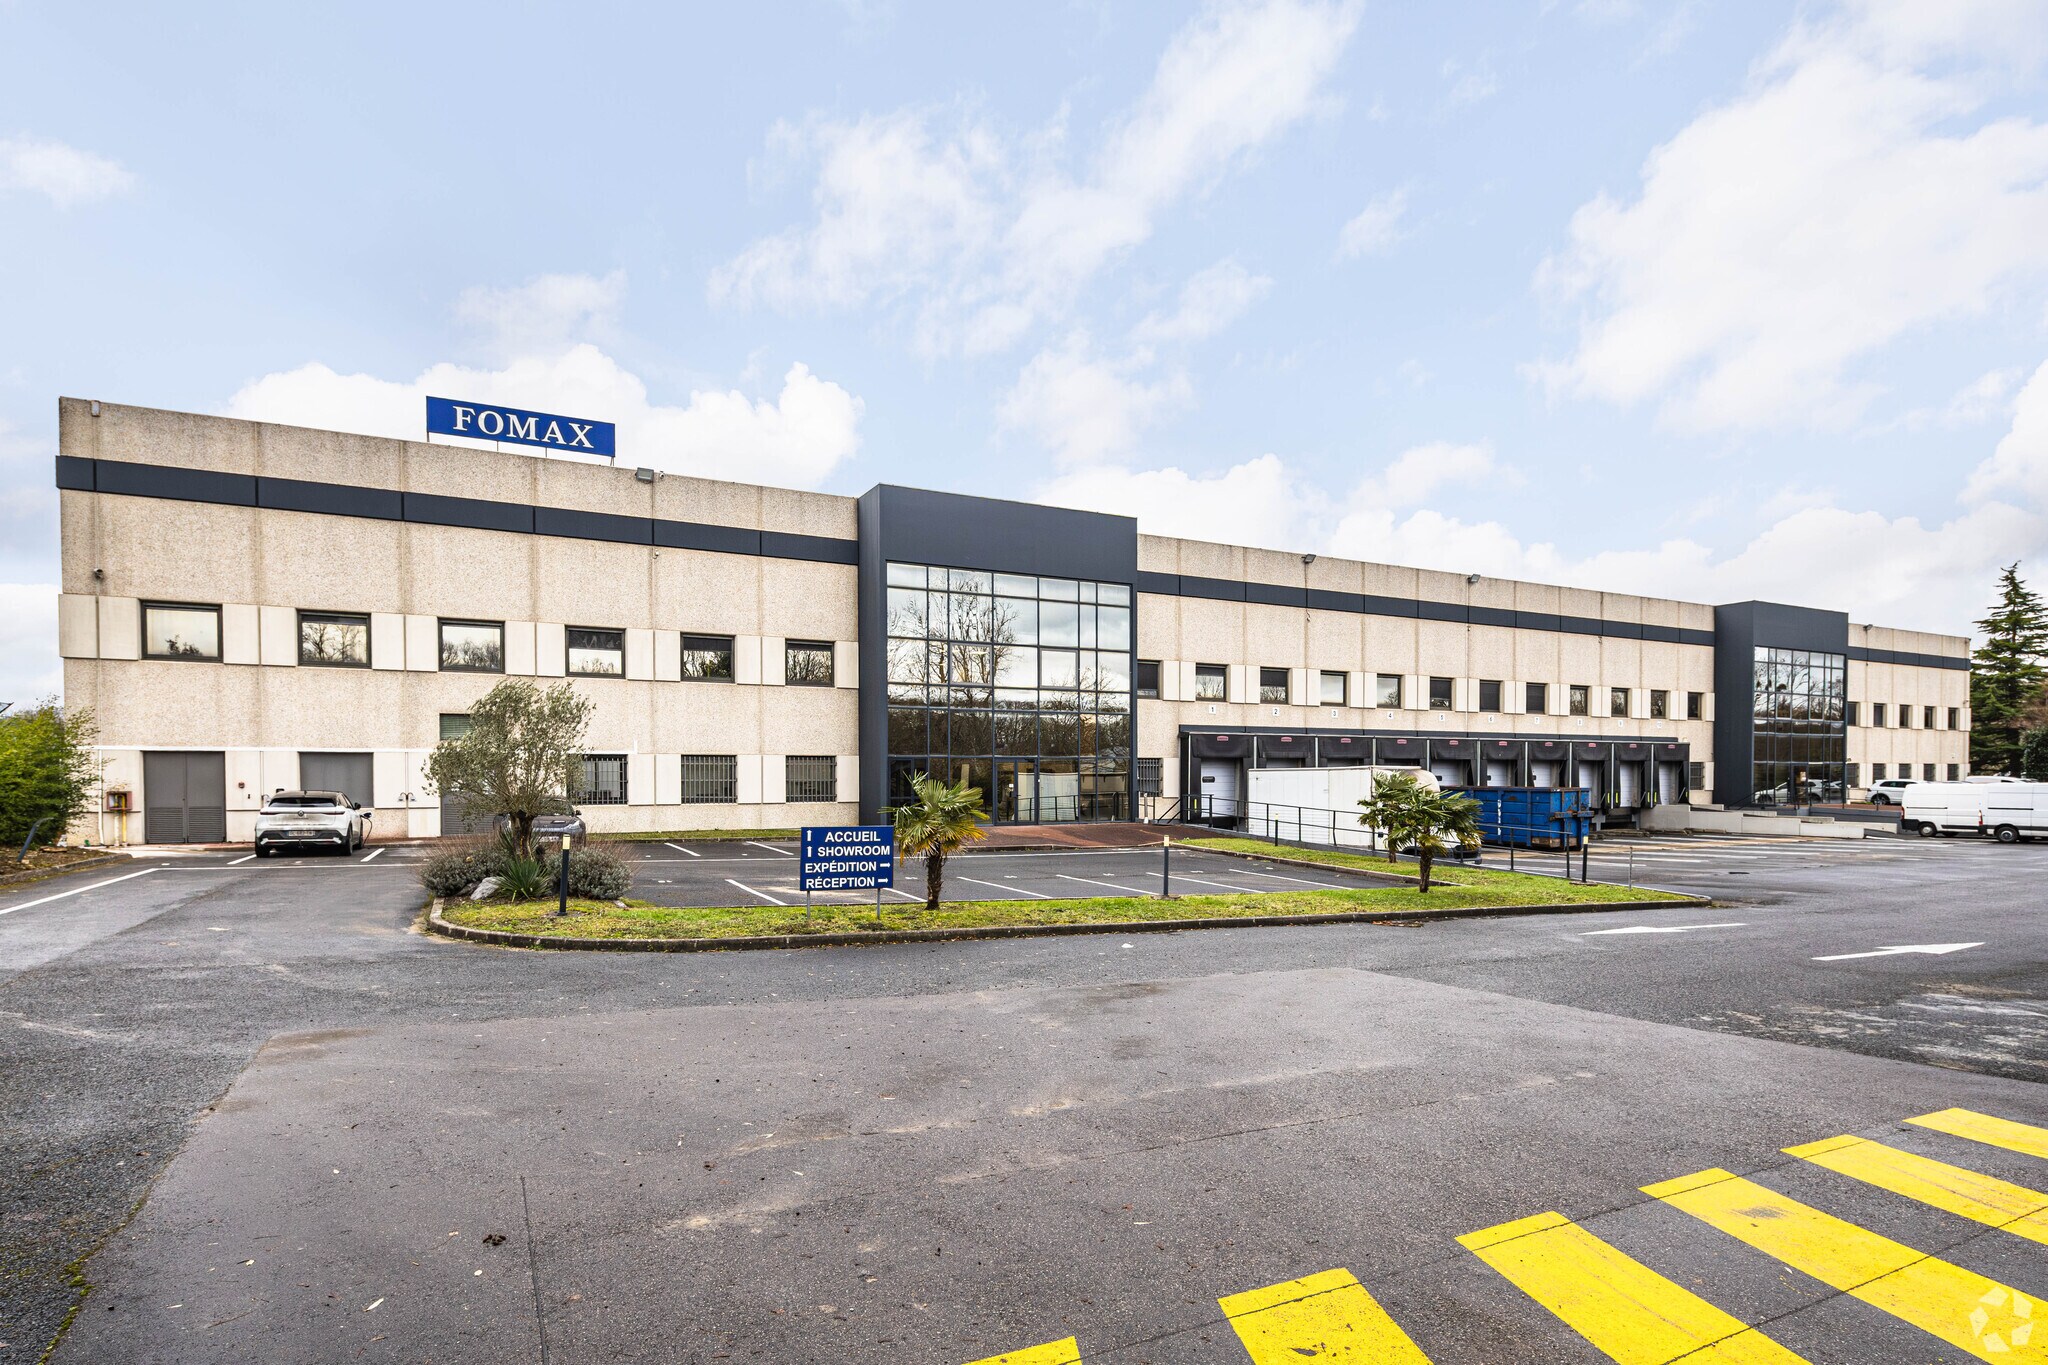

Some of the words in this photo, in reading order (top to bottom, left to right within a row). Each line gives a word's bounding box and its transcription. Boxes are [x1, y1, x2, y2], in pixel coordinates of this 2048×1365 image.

[453, 406, 594, 448] FOMAX
[825, 831, 881, 842] ACCUEIL
[817, 845, 890, 857] SHOWROOM
[805, 860, 876, 873] EXPÉDITION
[806, 876, 875, 889] RÉCEPTION
